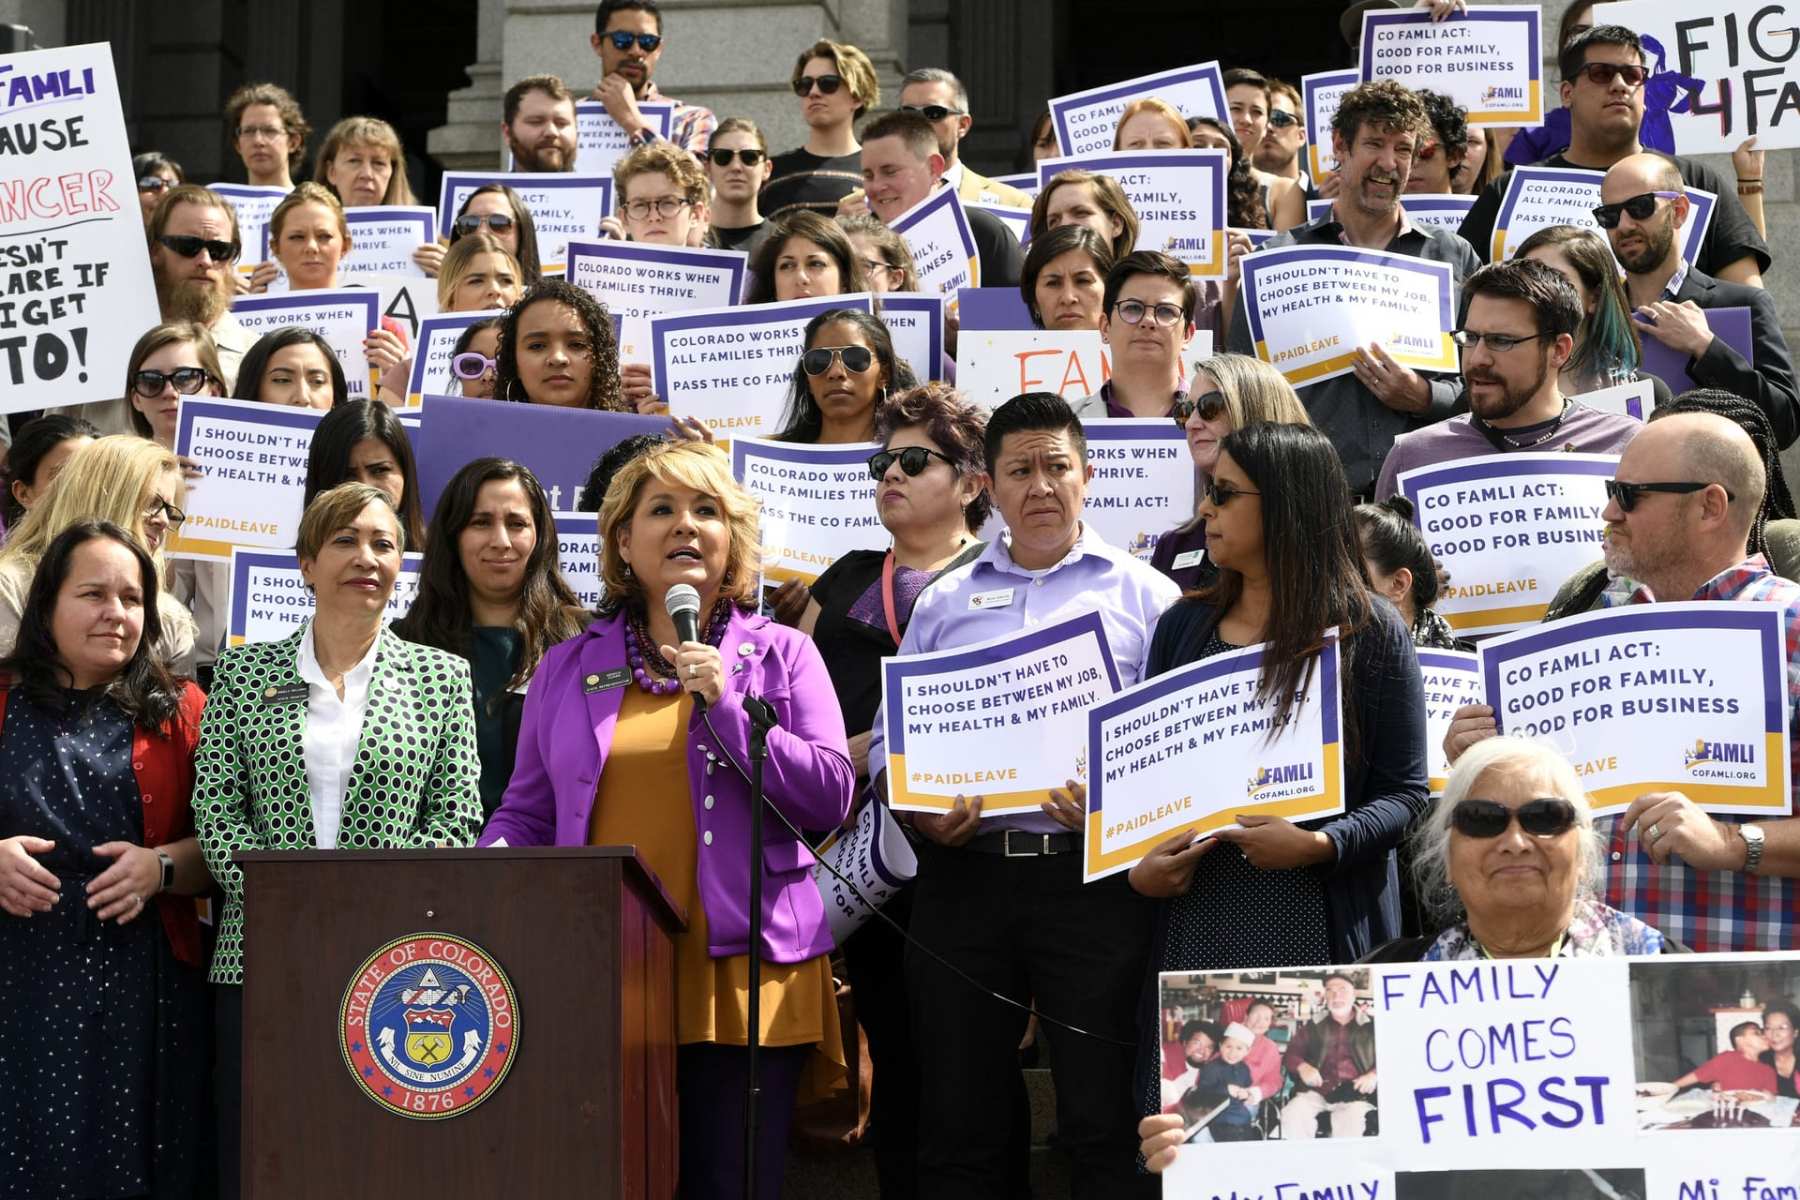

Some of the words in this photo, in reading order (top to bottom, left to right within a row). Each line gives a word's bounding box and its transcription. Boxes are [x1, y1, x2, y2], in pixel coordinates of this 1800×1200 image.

[1378, 31, 1394, 41] CO
[1398, 29, 1437, 40] FAMLI
[1441, 27, 1471, 39] ACT:
[1377, 48, 1412, 58] GOOD
[1416, 46, 1442, 56] FOR
[1447, 45, 1501, 56] FAMILY,
[1376, 65, 1412, 75] GOOD
[1417, 64, 1442, 74] FOR
[1448, 62, 1514, 73] BUSINESS
[1491, 87, 1523, 99] FAMLI
[1070, 112, 1086, 124] CO
[1073, 123, 1108, 140] GOOD
[1076, 139, 1112, 154] GOOD
[1120, 175, 1151, 185] ACT:
[1527, 185, 1592, 196] COLORADO
[1516, 213, 1546, 223] PASS
[1550, 216, 1573, 225] THE
[1577, 218, 1593, 227] CO
[1172, 238, 1206, 250] FAMLI
[73, 262, 110, 288] IF
[578, 262, 632, 276] COLORADO
[636, 267, 681, 281] WORKS
[685, 272, 720, 285] WHEN
[1258, 277, 1262, 287] I
[1265, 266, 1340, 285] SHOULDN'T
[1344, 267, 1378, 280] HAVE
[1384, 273, 1400, 283] TO
[596, 280, 645, 294] FAMILIES
[650, 285, 697, 299] THRIVE.
[1260, 282, 1309, 303] CHOOSE
[1312, 279, 1377, 293] BETWEEN
[1381, 286, 1399, 297] MY
[22, 292, 87, 326] GET
[1262, 308, 1279, 320] MY
[1282, 295, 1331, 313] HEALTH
[1335, 294, 1344, 303] &
[1349, 294, 1367, 304] MY
[266, 313, 311, 326] WORKS
[316, 310, 353, 321] WHEN
[670, 332, 745, 348] COLORADO
[749, 327, 800, 343] WORKS
[0, 327, 89, 386] TO!
[671, 352, 697, 365] ALL
[701, 348, 764, 364] FAMILIES
[1272, 335, 1340, 363] #PAIDLEAVE
[673, 378, 708, 391] PASS
[711, 377, 739, 389] THE
[743, 375, 761, 386] CO
[196, 427, 200, 437] I
[205, 427, 292, 449] SHOULDN'T
[193, 446, 254, 463] CHOOSE
[1130, 447, 1178, 459] WHEN
[217, 467, 276, 484] HEALTH
[281, 474, 291, 486] &
[750, 463, 829, 483] COLORADO
[1091, 467, 1149, 479] THRIVE.
[750, 479, 775, 493] ALL
[780, 484, 846, 501] FAMILIES
[1424, 494, 1450, 510] CO
[1457, 485, 1516, 505] FAMLI
[1522, 482, 1565, 497] ACT:
[1134, 496, 1169, 508] ACT!
[185, 515, 279, 536] #PAIDLEAVE
[789, 511, 816, 526] THE
[820, 516, 840, 528] CO
[1427, 514, 1483, 533] GOOD
[1489, 510, 1528, 526] FOR
[1431, 538, 1486, 557] GOOD
[1492, 533, 1531, 550] FOR
[253, 575, 257, 586] I
[252, 592, 316, 608] CHOOSE
[251, 609, 274, 621] MY
[1506, 667, 1532, 686] CO
[1538, 649, 1601, 678] FAMLI
[1608, 641, 1661, 661] ACT:
[907, 686, 912, 697] I
[917, 671, 1012, 697] SHOULDN'T
[1015, 658, 1051, 681] HAVE
[1052, 654, 1069, 668] TO
[907, 699, 976, 716] CHOOSE
[982, 678, 1054, 710] BETWEEN
[1057, 675, 1073, 691] MY
[1077, 667, 1103, 687] JOB,
[1507, 687, 1564, 714] GOOD
[1570, 676, 1612, 698] FOR
[1620, 668, 1715, 689] FAMILY,
[908, 722, 933, 735] MY
[939, 716, 1005, 733] HEALTH
[1011, 713, 1022, 725] &
[1027, 705, 1048, 722] MY
[1052, 691, 1101, 716] FAMILY.
[1105, 730, 1110, 742] I
[1114, 697, 1195, 739] SHOULDN'T
[1198, 679, 1240, 704] HAVE
[1511, 714, 1566, 740] GOOD
[1572, 703, 1614, 727] FOR
[1621, 697, 1740, 716] BUSINESS
[1105, 733, 1161, 763] CHOOSE
[1164, 706, 1238, 738] BETWEEN
[1242, 697, 1267, 713] MY
[1105, 766, 1126, 784] MY
[1129, 742, 1184, 774] HEALTH
[1188, 737, 1198, 750] &
[1203, 727, 1226, 745] MY
[1703, 741, 1755, 764] FAMLI
[911, 768, 1018, 785] #PAIDLEAVE
[1263, 761, 1314, 786] FAMLI
[1691, 768, 1757, 780] COFAMLI.ORG
[1253, 784, 1316, 802] COFAMLI.ORG
[862, 811, 871, 833] CO
[1105, 795, 1193, 840] #PAIDLEAVE
[857, 838, 874, 889] FAMLI
[832, 883, 855, 919] FOR
[348, 966, 386, 1028] STATE
[390, 942, 417, 966] OF
[428, 941, 512, 1029] COLORADO
[1382, 963, 1560, 1011] FAMILY
[1425, 1016, 1577, 1073] COMES
[388, 1056, 401, 1071] NIL
[405, 1068, 425, 1081] SINE
[429, 1061, 467, 1082] NUMINE
[402, 1091, 455, 1112] 1876
[1413, 1075, 1611, 1145] FIRST
